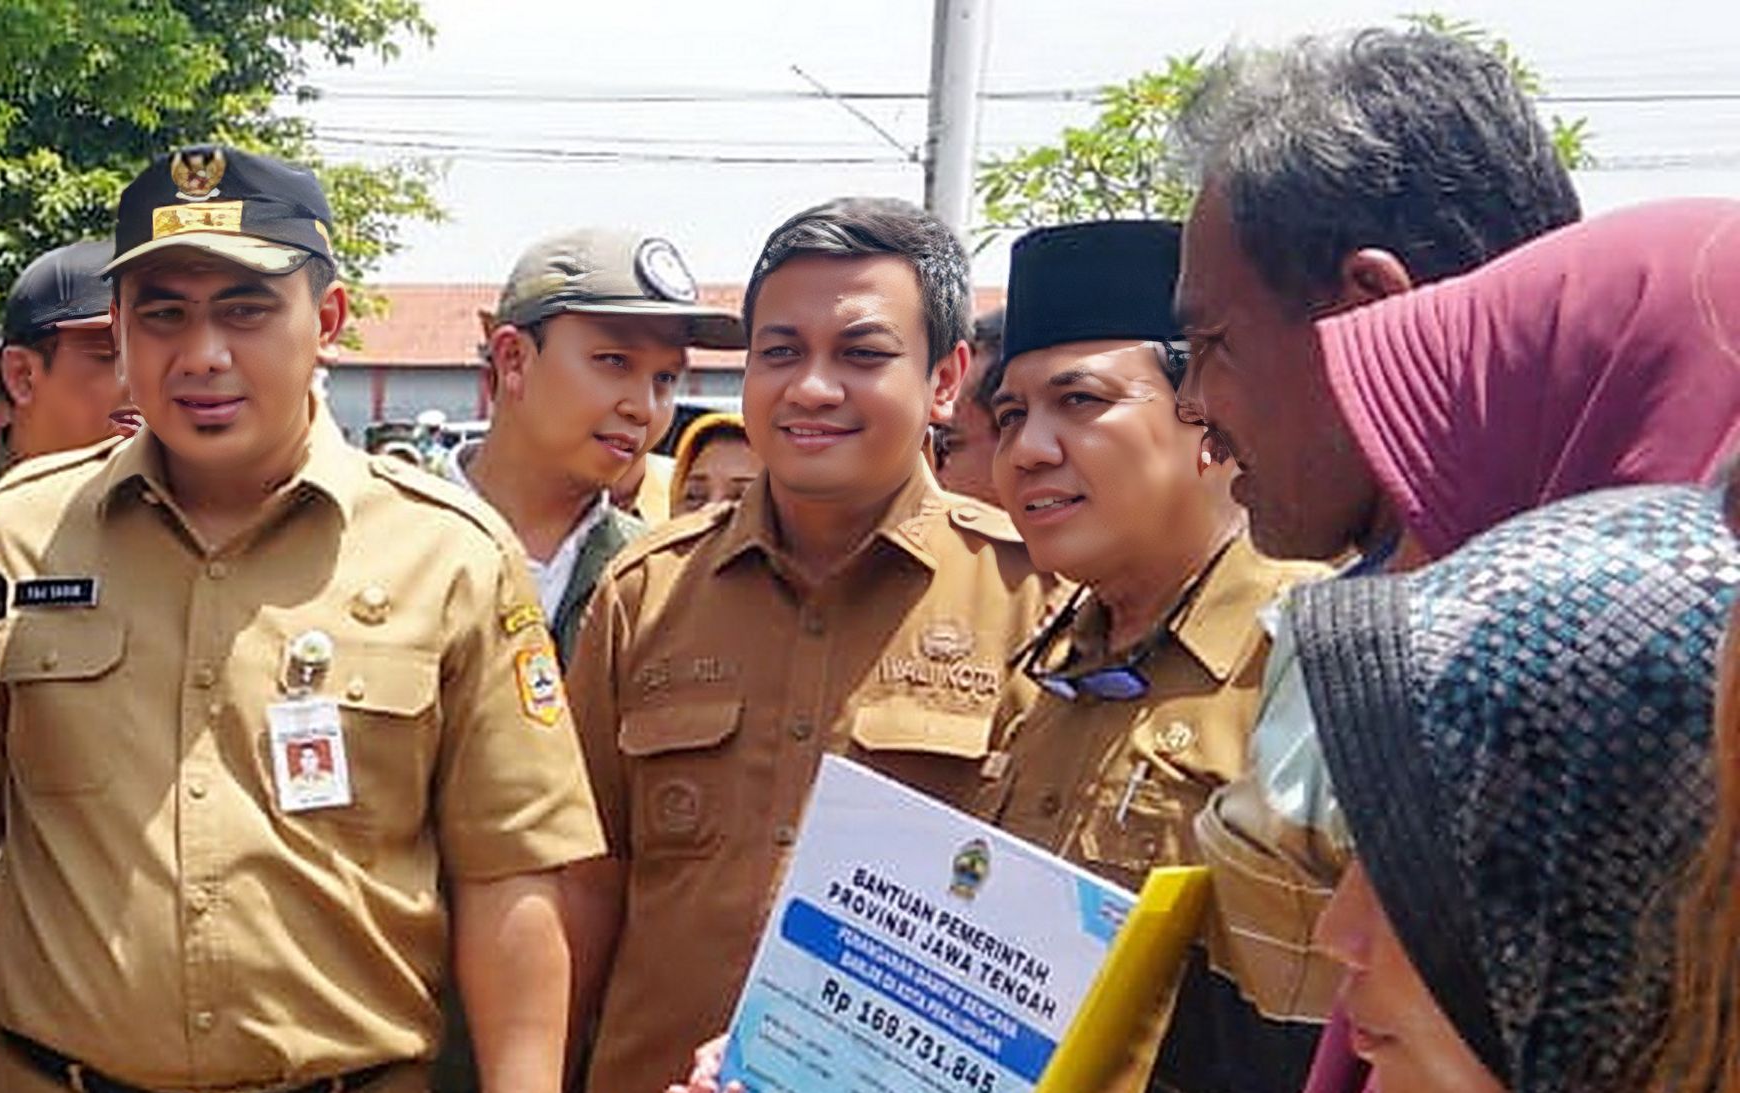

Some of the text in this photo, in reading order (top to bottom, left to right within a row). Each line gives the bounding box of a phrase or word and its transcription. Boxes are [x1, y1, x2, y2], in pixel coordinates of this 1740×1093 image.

[827, 882, 1057, 1020] PROVINSI JAWA TENGAH
[853, 868, 933, 924] BANTUAN
[938, 911, 1050, 984] PEMERINTAH
[821, 979, 852, 1014] Rp
